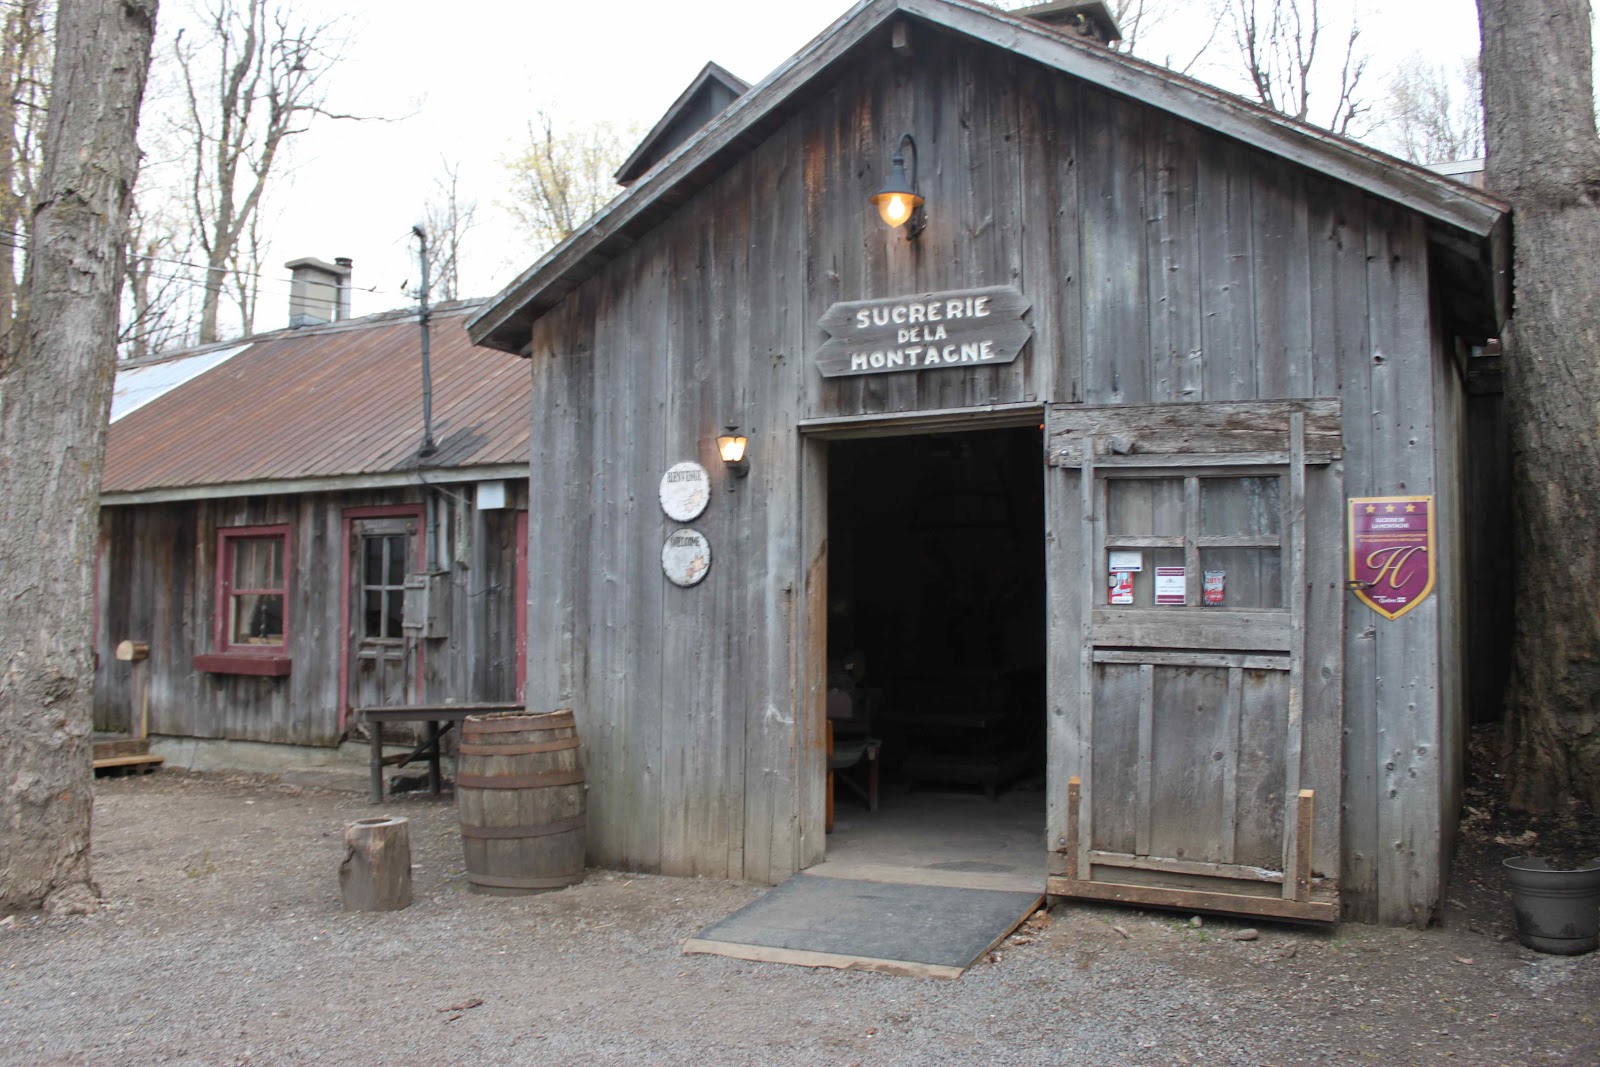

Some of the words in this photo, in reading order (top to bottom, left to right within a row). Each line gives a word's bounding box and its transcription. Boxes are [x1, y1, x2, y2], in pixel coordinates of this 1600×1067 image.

[856, 296, 991, 328] SUCRERIE
[897, 327, 920, 344] DE
[923, 324, 947, 341] LA
[851, 340, 995, 371] MONTAGNE
[667, 470, 702, 483] BIENVENUE
[670, 536, 701, 548] WELCOME
